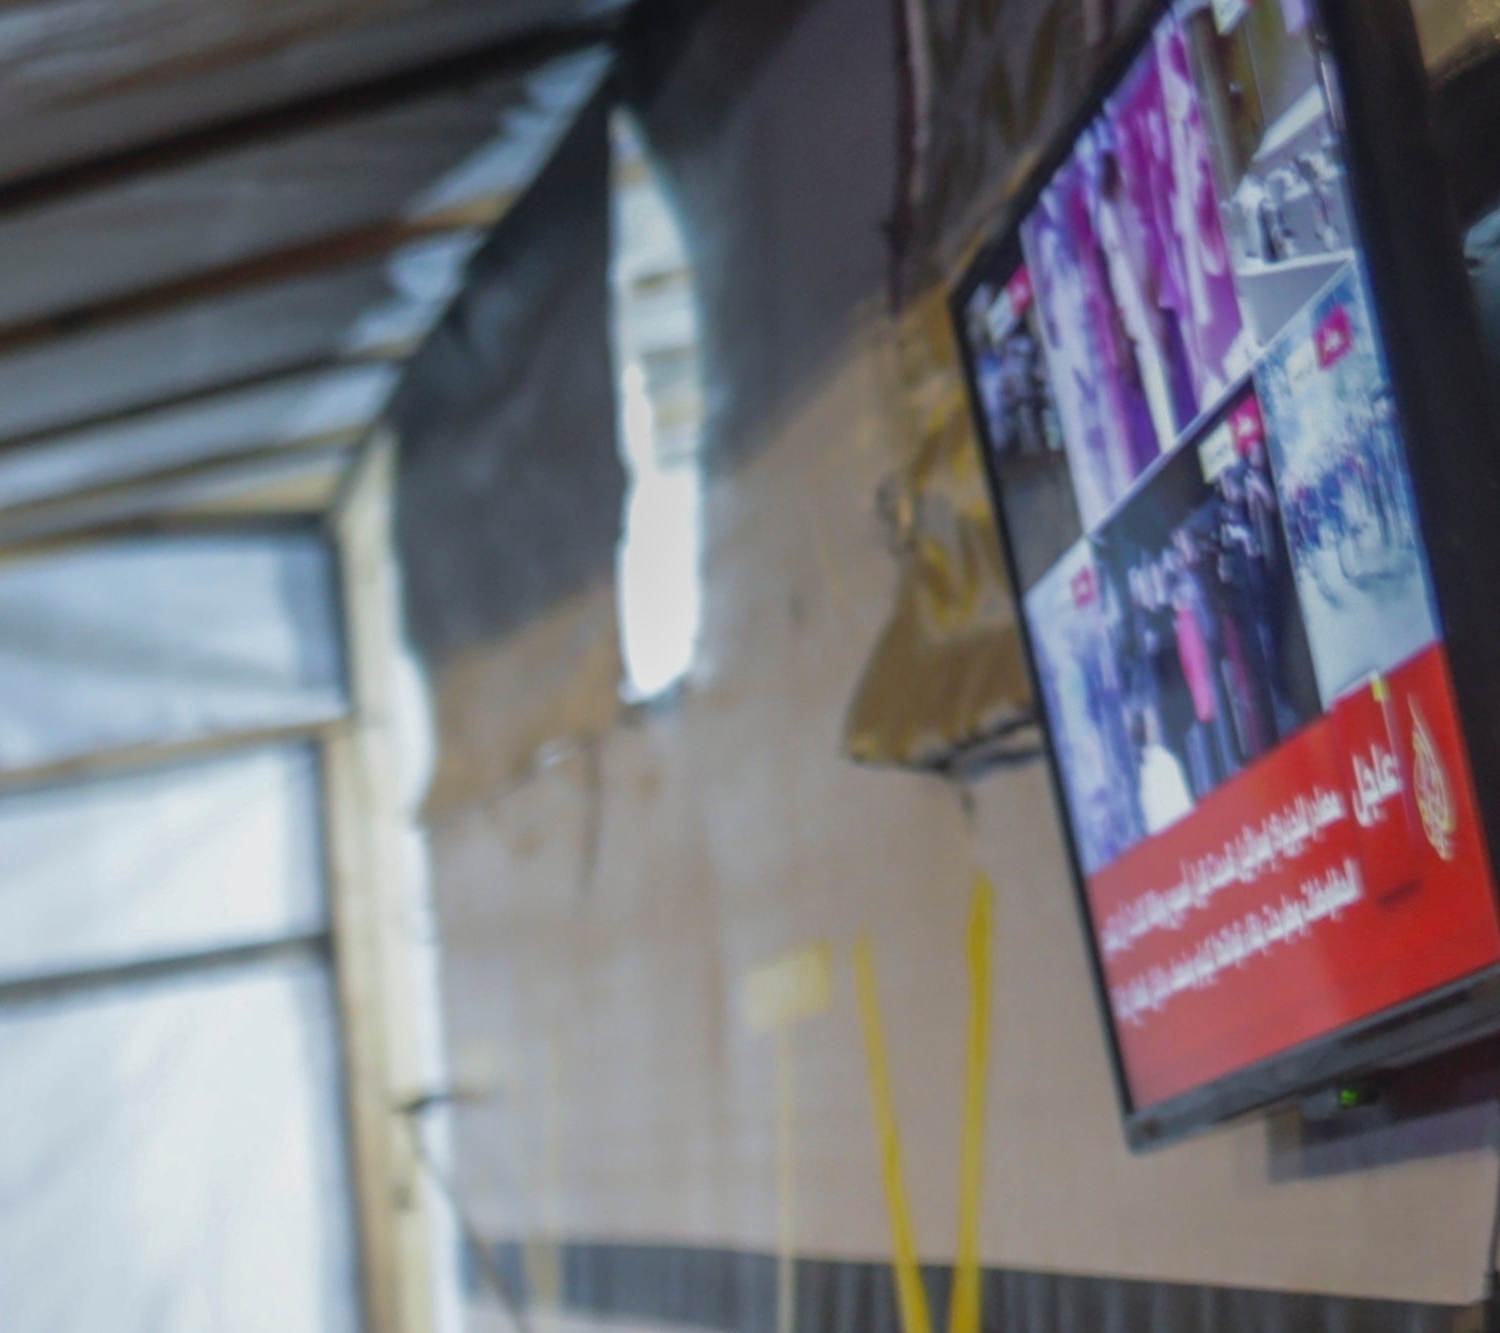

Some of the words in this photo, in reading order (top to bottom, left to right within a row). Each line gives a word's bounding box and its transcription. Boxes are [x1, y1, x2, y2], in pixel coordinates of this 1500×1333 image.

[1303, 785, 1345, 842] مصادر
[1351, 743, 1403, 827] عاجل
[1300, 857, 1363, 922] المفاوضات
